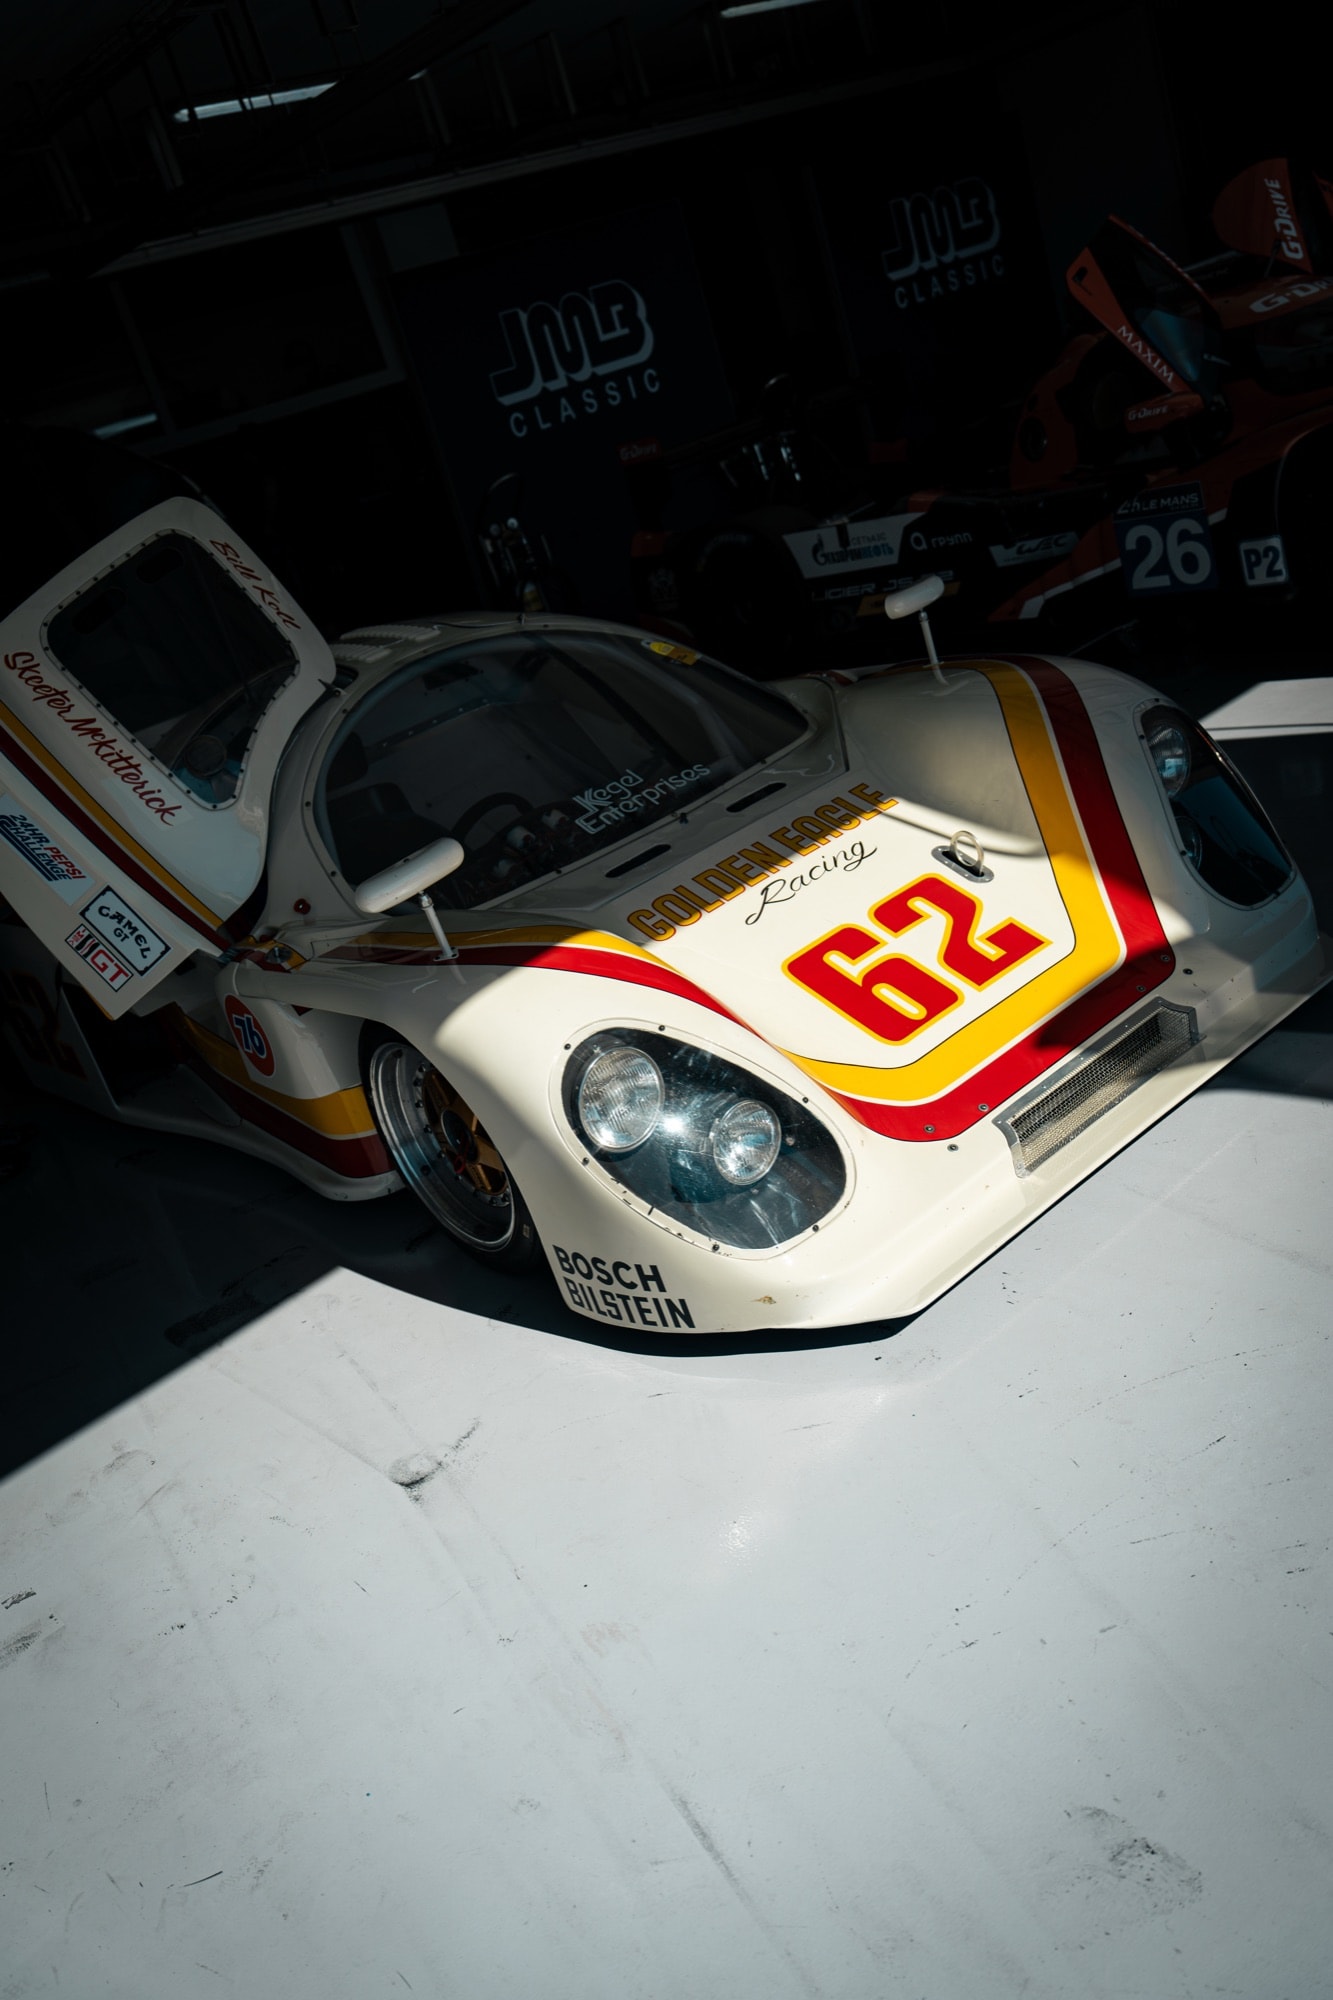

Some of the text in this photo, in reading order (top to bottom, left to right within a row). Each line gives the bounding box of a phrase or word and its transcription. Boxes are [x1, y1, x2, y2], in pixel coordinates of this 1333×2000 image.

[879, 175, 1002, 283] JMB
[893, 253, 1006, 310] CLASSIC
[487, 278, 656, 408] JMB
[1117, 324, 1175, 383] MAXIM
[508, 367, 661, 439] CLASSIC
[1159, 491, 1200, 509] MANS
[209, 539, 263, 581] Bill
[1124, 517, 1212, 590] 26
[1243, 545, 1284, 580] P2
[4, 651, 76, 722] Skeeter
[572, 768, 644, 815] Kegel
[574, 763, 711, 835] Enterprises
[43, 846, 87, 880] PEPSI
[626, 782, 899, 942] GOLDEN EAGLE
[744, 840, 878, 926] Racing
[97, 905, 152, 960] CAMEL
[112, 927, 130, 943] GT
[780, 872, 1054, 1047] 62
[90, 949, 129, 983] GT
[232, 1013, 267, 1059] 76
[552, 1244, 667, 1293] BOSCH
[563, 1276, 696, 1329] BILSTEIN
